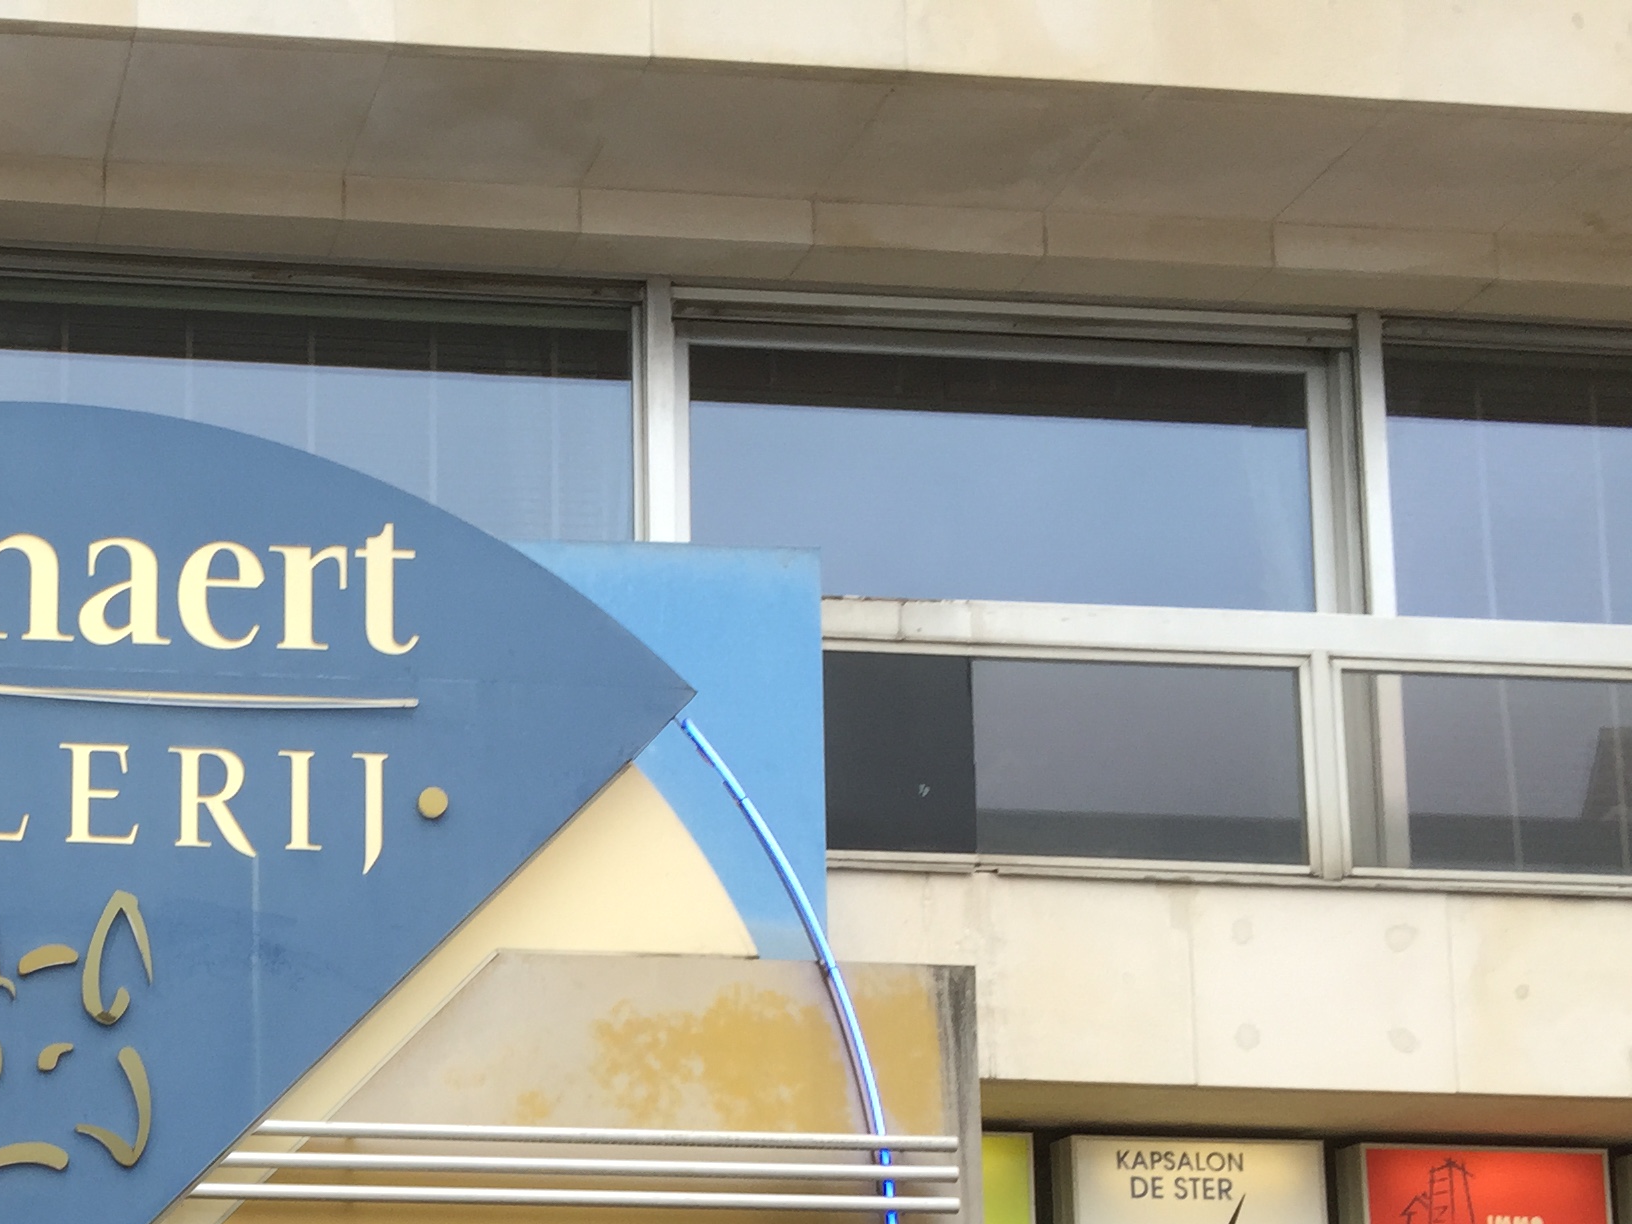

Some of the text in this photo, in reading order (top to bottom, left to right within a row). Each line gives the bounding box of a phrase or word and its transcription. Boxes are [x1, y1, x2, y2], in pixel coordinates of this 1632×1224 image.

[1116, 1150, 1245, 1173] KAPSALON
[1130, 1176, 1233, 1201] DE STER
